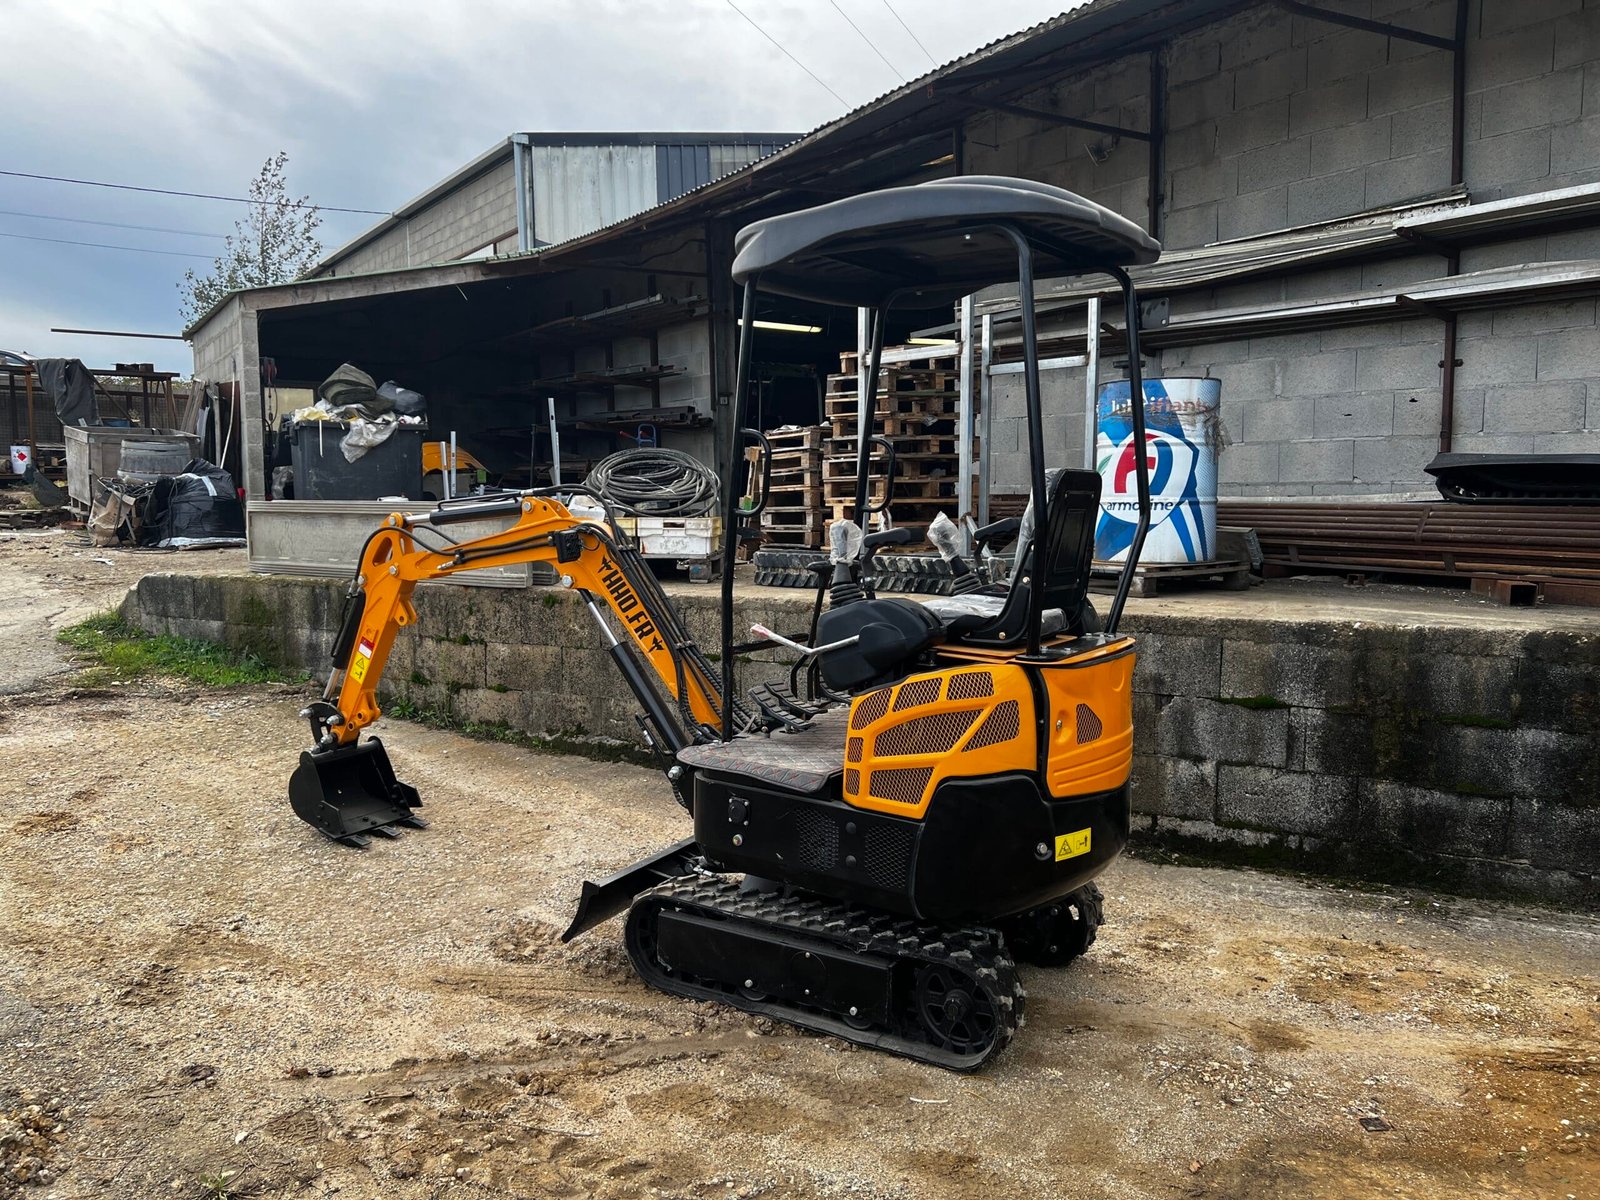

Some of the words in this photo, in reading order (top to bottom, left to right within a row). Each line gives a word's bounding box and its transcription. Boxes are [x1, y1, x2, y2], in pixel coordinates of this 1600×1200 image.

[1111, 397, 1208, 413] luifiants
[1106, 498, 1174, 511] armoine
[602, 570, 655, 640] HHO.FR
